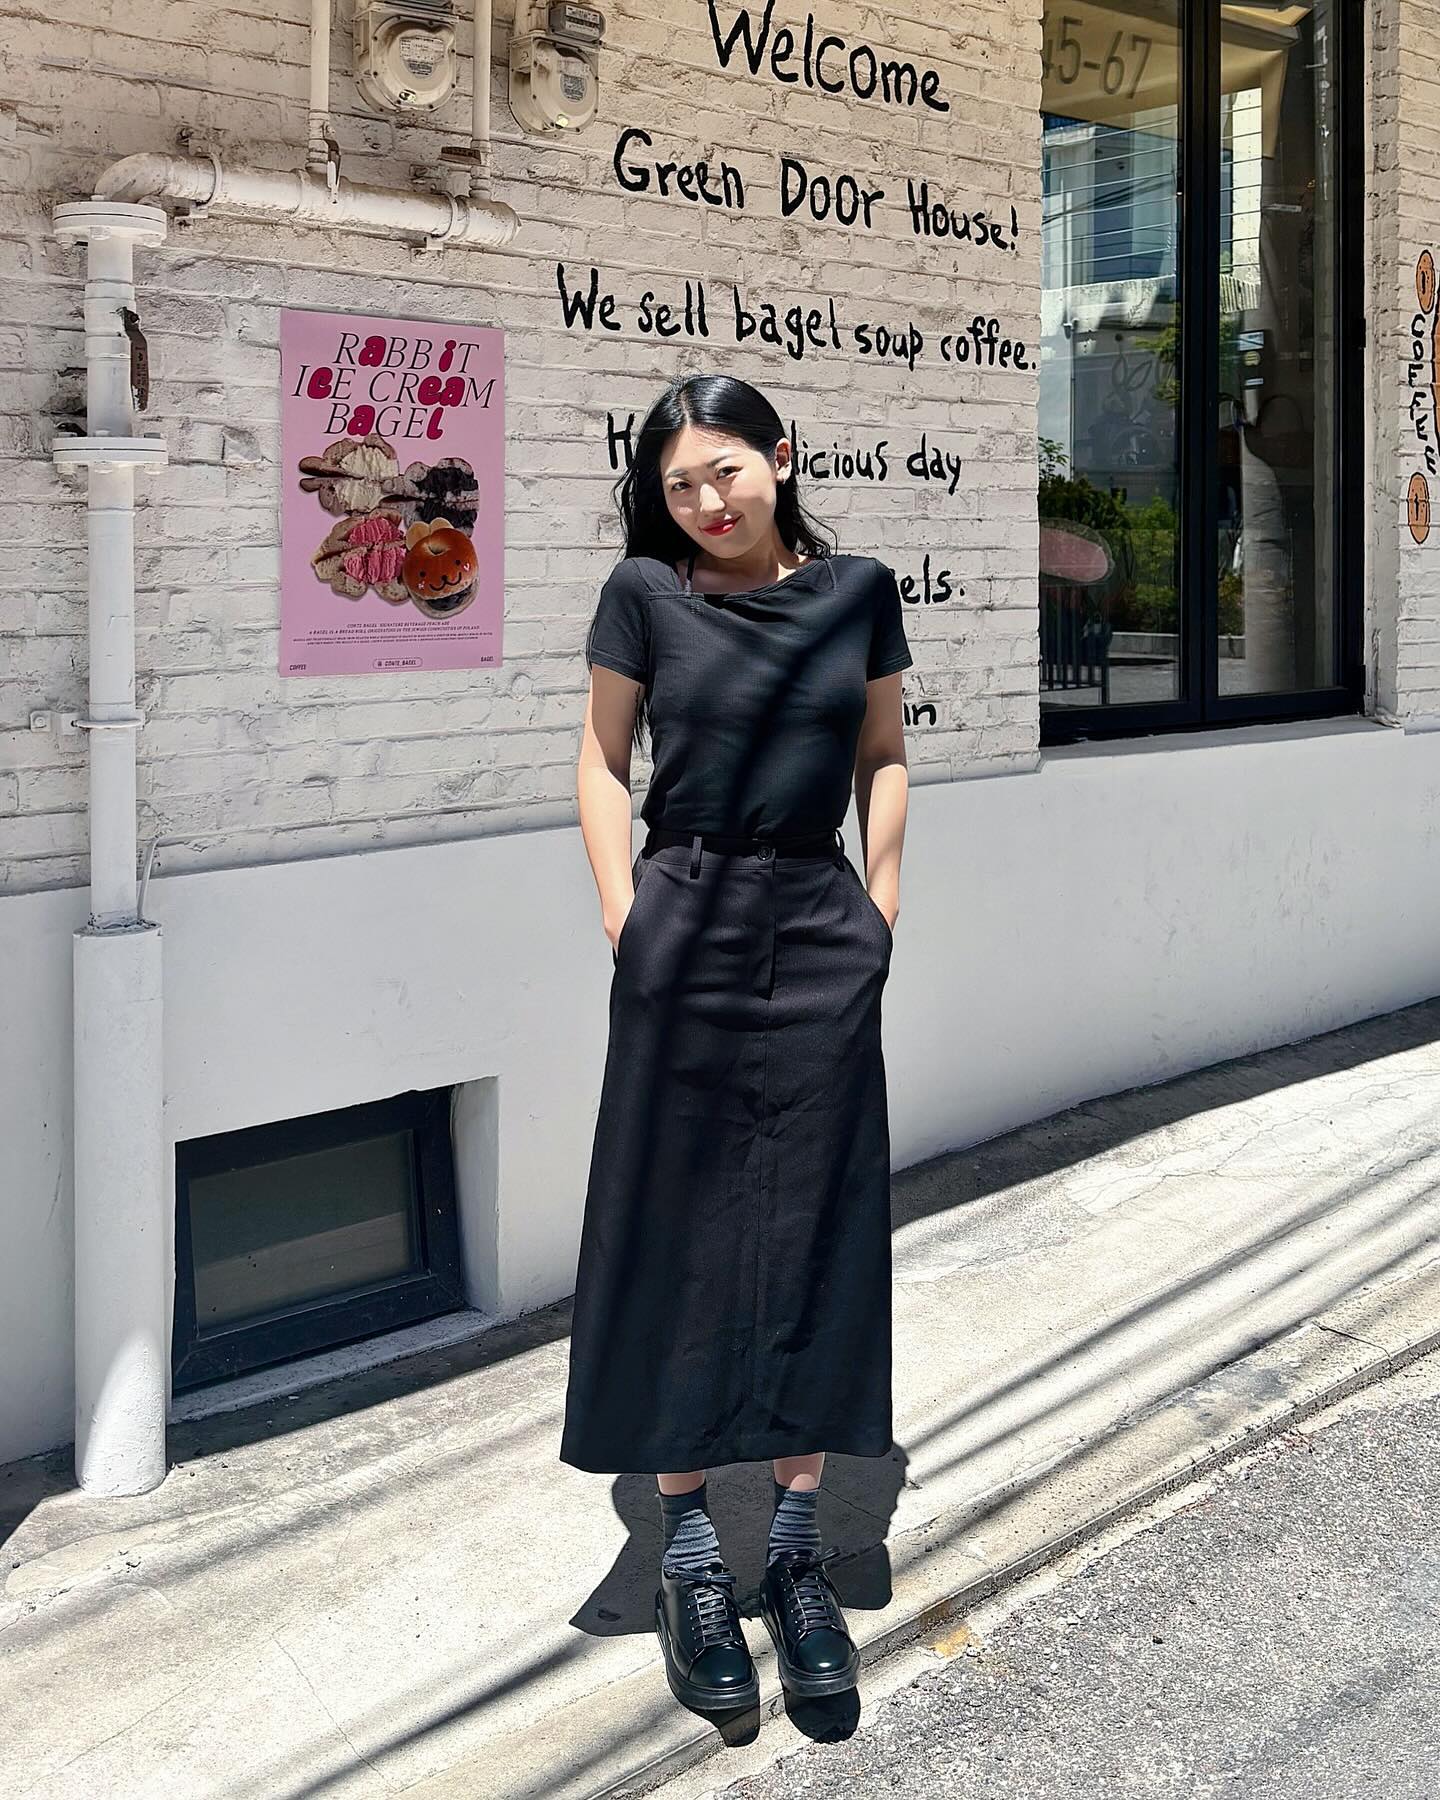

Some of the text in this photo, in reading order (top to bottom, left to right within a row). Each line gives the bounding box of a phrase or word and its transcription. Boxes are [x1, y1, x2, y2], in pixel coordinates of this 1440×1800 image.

[706, 0, 950, 112] Welcome
[613, 127, 745, 211] Green
[906, 179, 1019, 251] House!
[556, 262, 1038, 372] We sell bagel soup coffee.
[906, 432, 961, 496] day
